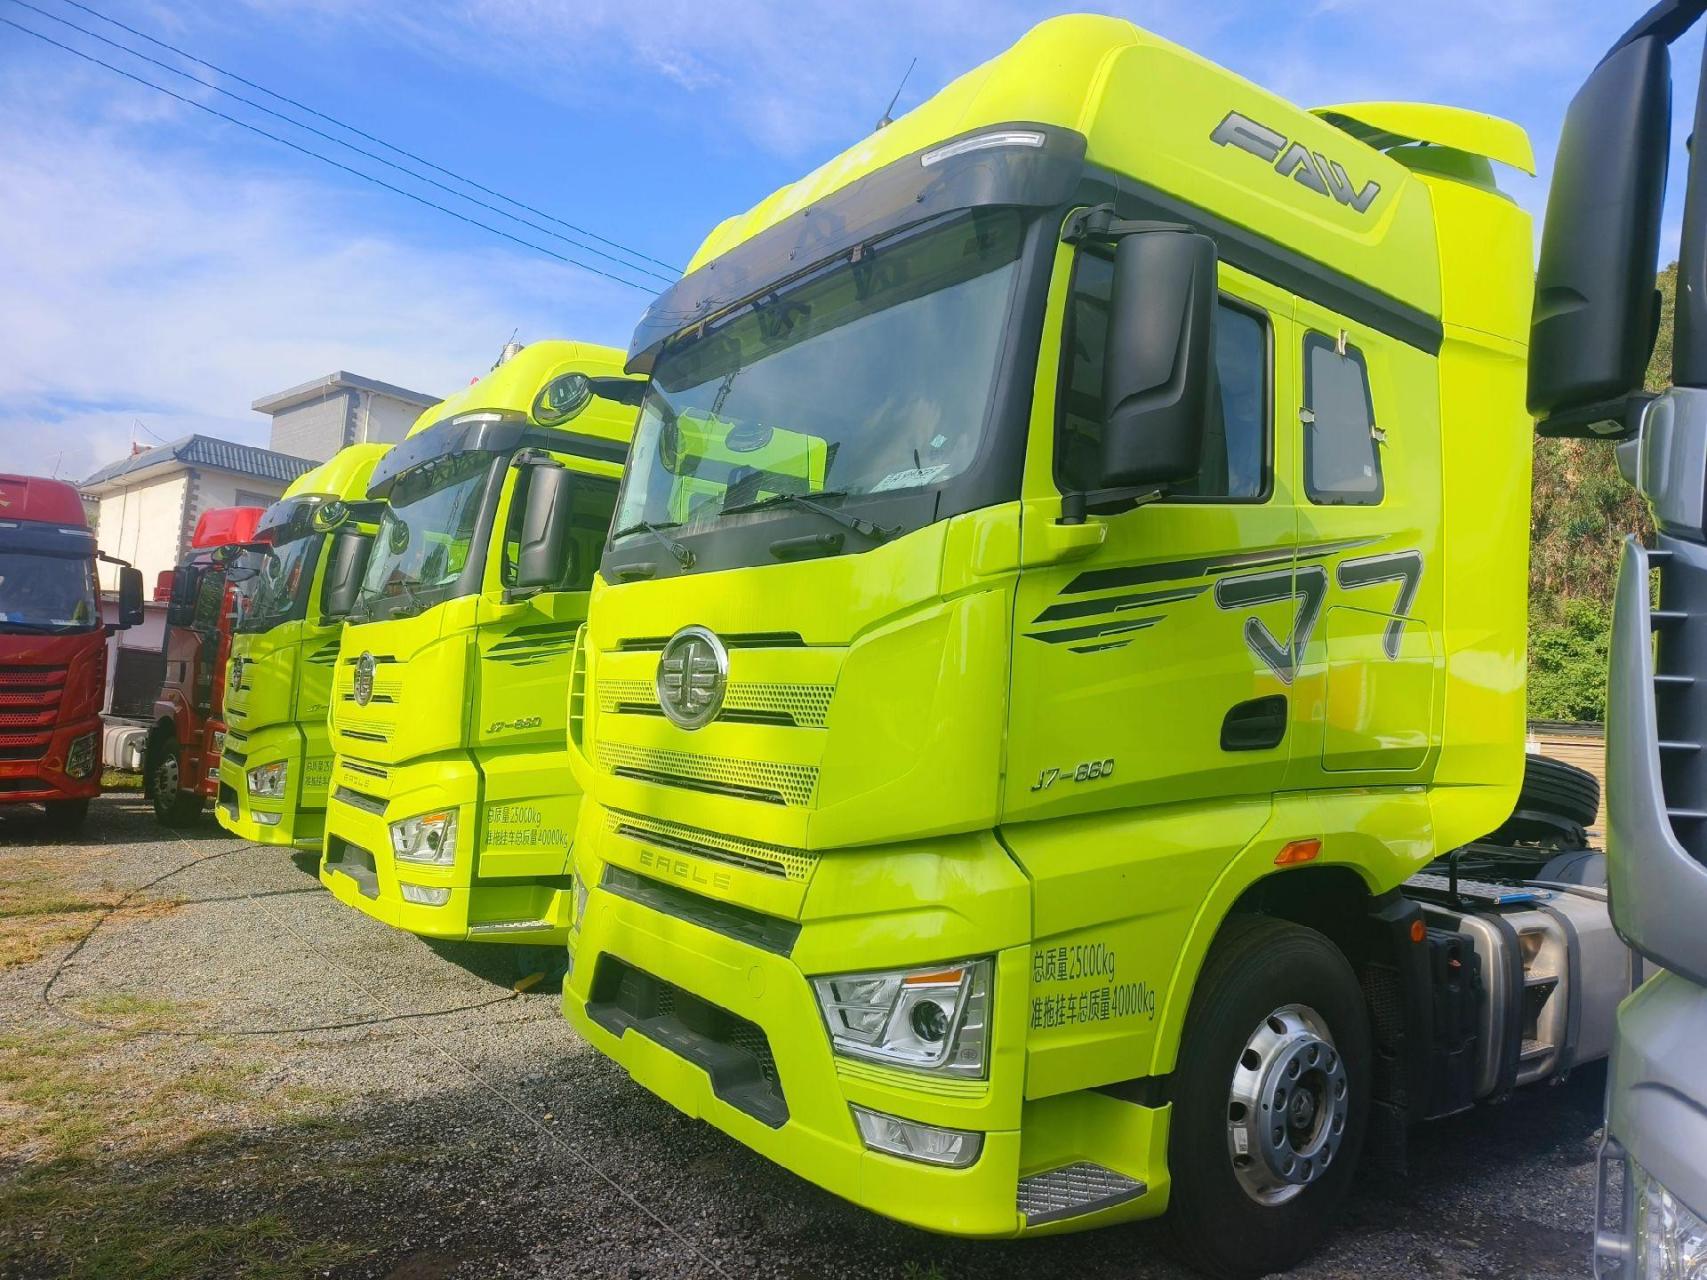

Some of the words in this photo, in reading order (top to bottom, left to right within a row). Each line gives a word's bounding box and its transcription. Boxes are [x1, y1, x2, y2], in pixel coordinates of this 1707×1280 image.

[1209, 110, 1381, 214] FAW
[1214, 549, 1424, 686] J7
[640, 848, 731, 891] EAGLE
[1032, 942, 1115, 983] 总质量25000kg
[1030, 981, 1155, 1030] 准拖挂车总质量40000kg
